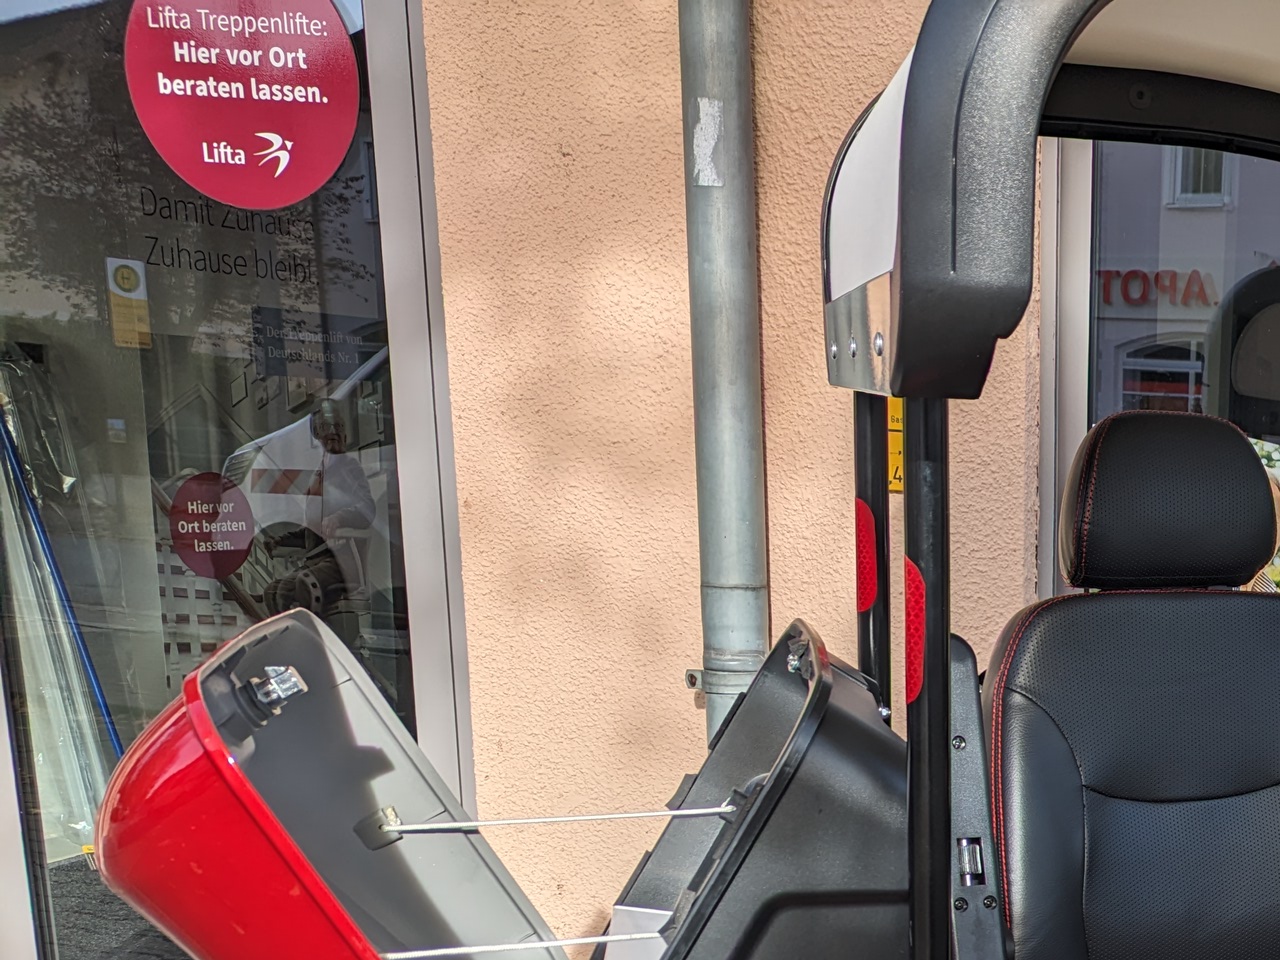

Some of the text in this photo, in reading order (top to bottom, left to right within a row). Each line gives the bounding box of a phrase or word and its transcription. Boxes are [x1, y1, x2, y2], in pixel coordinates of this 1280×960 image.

[146, 6, 328, 37] Lifta Treppenlifte:
[173, 40, 307, 69] Hier vor Ort
[157, 72, 328, 103] beraten lassen.
[202, 142, 246, 165] Lifta
[140, 186, 214, 226] Damit
[145, 236, 320, 286] Zuhause bleibt.
[266, 326, 285, 338] Der
[346, 335, 363, 345] von
[268, 346, 335, 363] Deutschlands
[338, 351, 352, 364] Nr.
[187, 500, 235, 514] Hier vor
[178, 520, 247, 534] Ort beraten
[194, 539, 235, 553] lassen.
